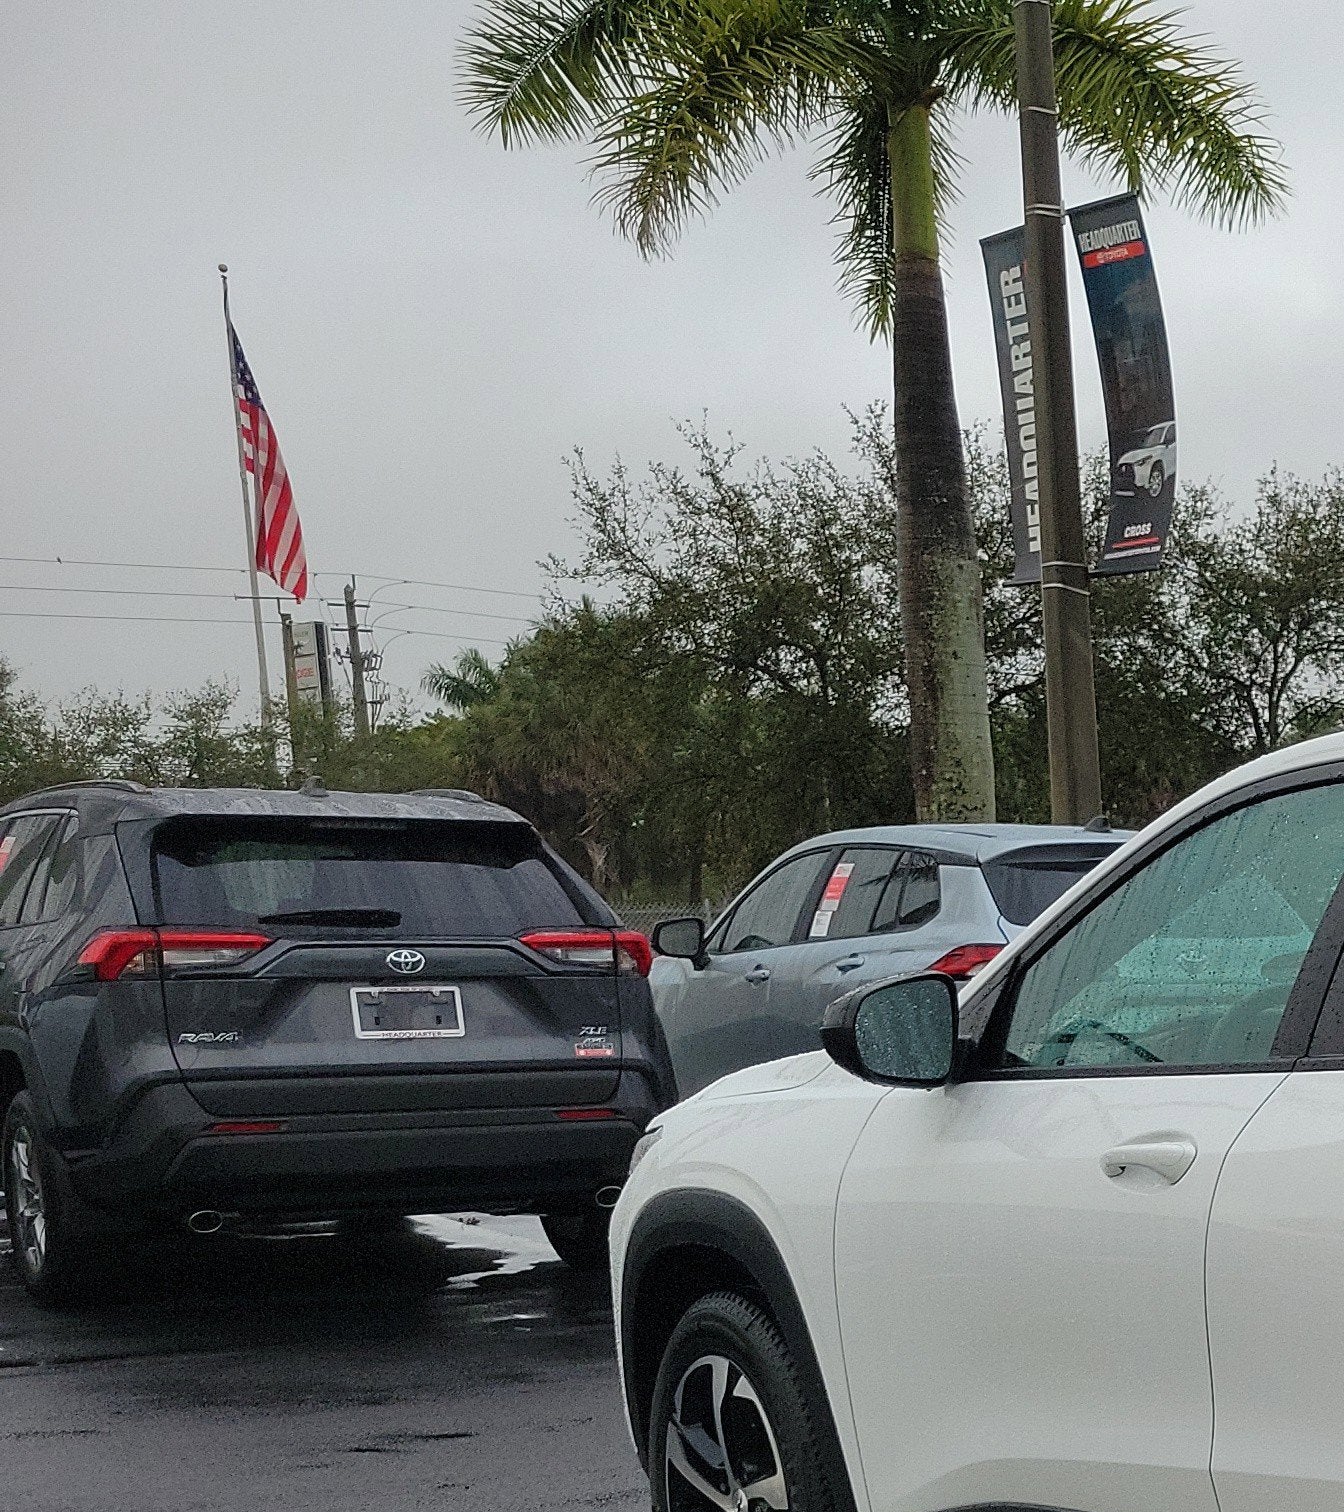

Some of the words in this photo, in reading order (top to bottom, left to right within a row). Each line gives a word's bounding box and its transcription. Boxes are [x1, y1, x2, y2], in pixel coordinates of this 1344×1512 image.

[1078, 219, 1141, 252] HEADQUARTER
[1123, 522, 1153, 538] CROSS
[579, 1026, 607, 1035] XLE
